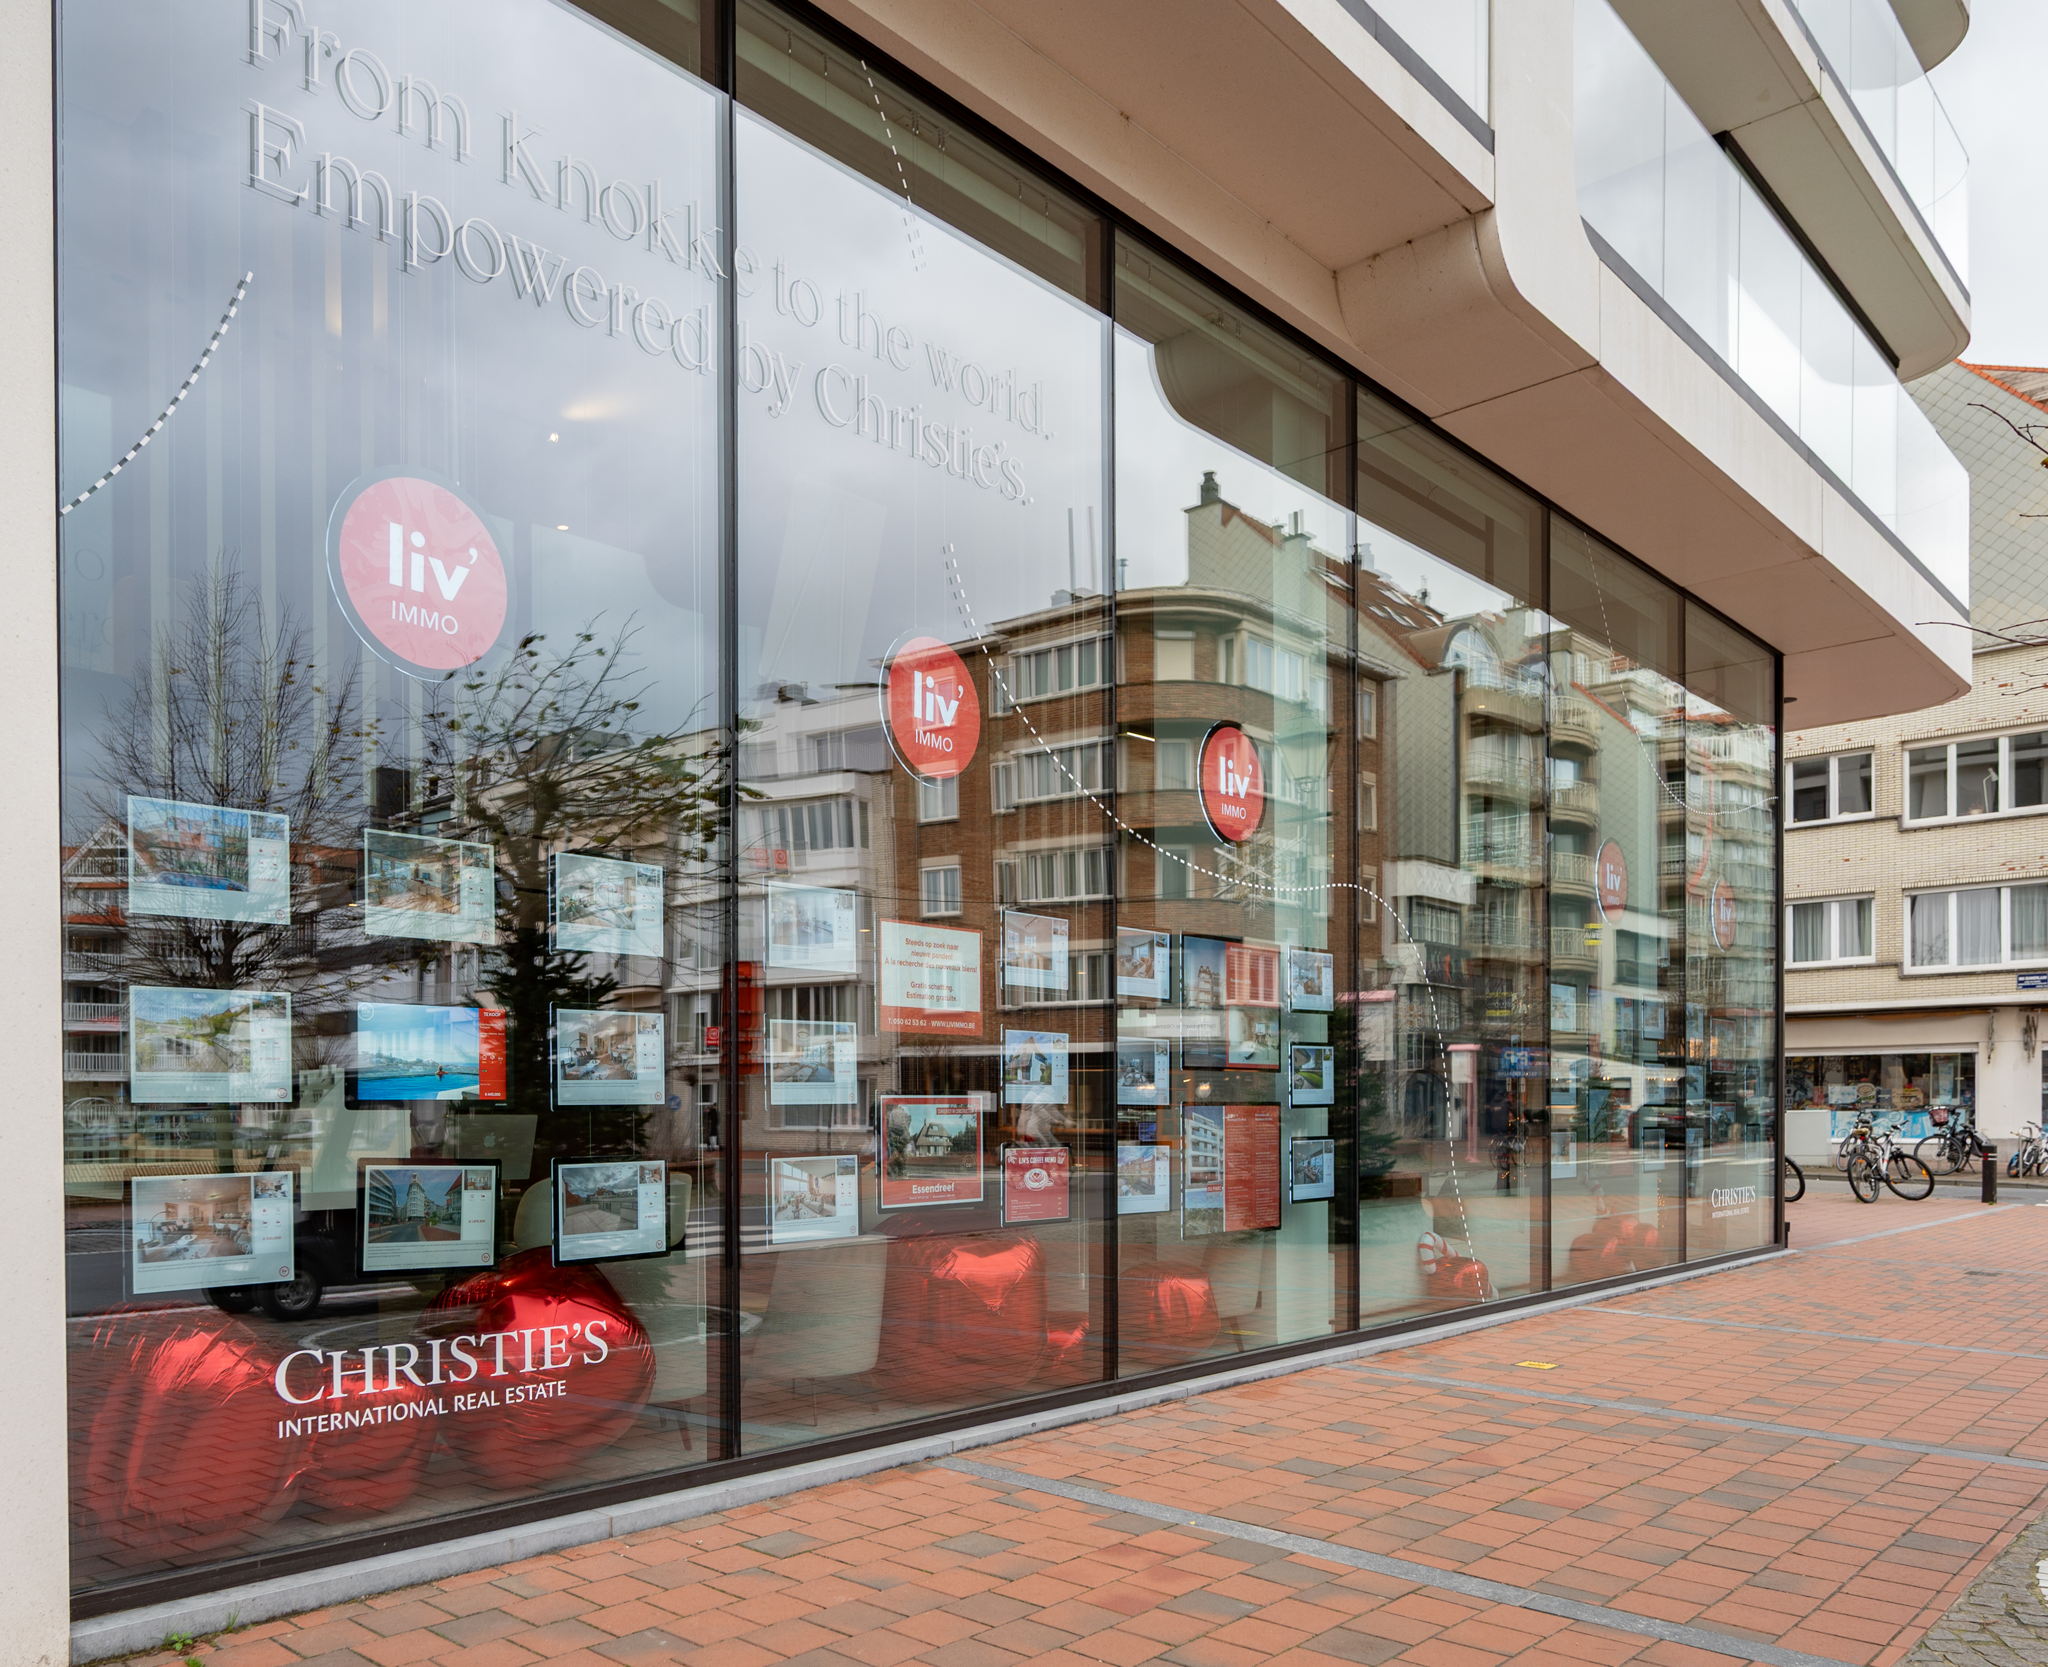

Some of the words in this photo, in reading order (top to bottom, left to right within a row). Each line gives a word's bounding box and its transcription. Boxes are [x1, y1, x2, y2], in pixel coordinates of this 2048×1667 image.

[239, 98, 721, 376] Empowered
[736, 320, 806, 419] by
[496, 109, 762, 298] Knokke
[771, 255, 824, 327] to
[834, 287, 914, 371] the
[923, 340, 1055, 440] world.
[391, 600, 459, 635] IMMO
[915, 728, 954, 753] IMMO
[1221, 803, 1247, 820] IMMO
[912, 1182, 955, 1194] Essendreef
[274, 1320, 610, 1405] CHRISTIE'S
[277, 1397, 449, 1439] INTERNATIONAL
[453, 1389, 501, 1412] REAL
[504, 1380, 568, 1405] ESTATE
